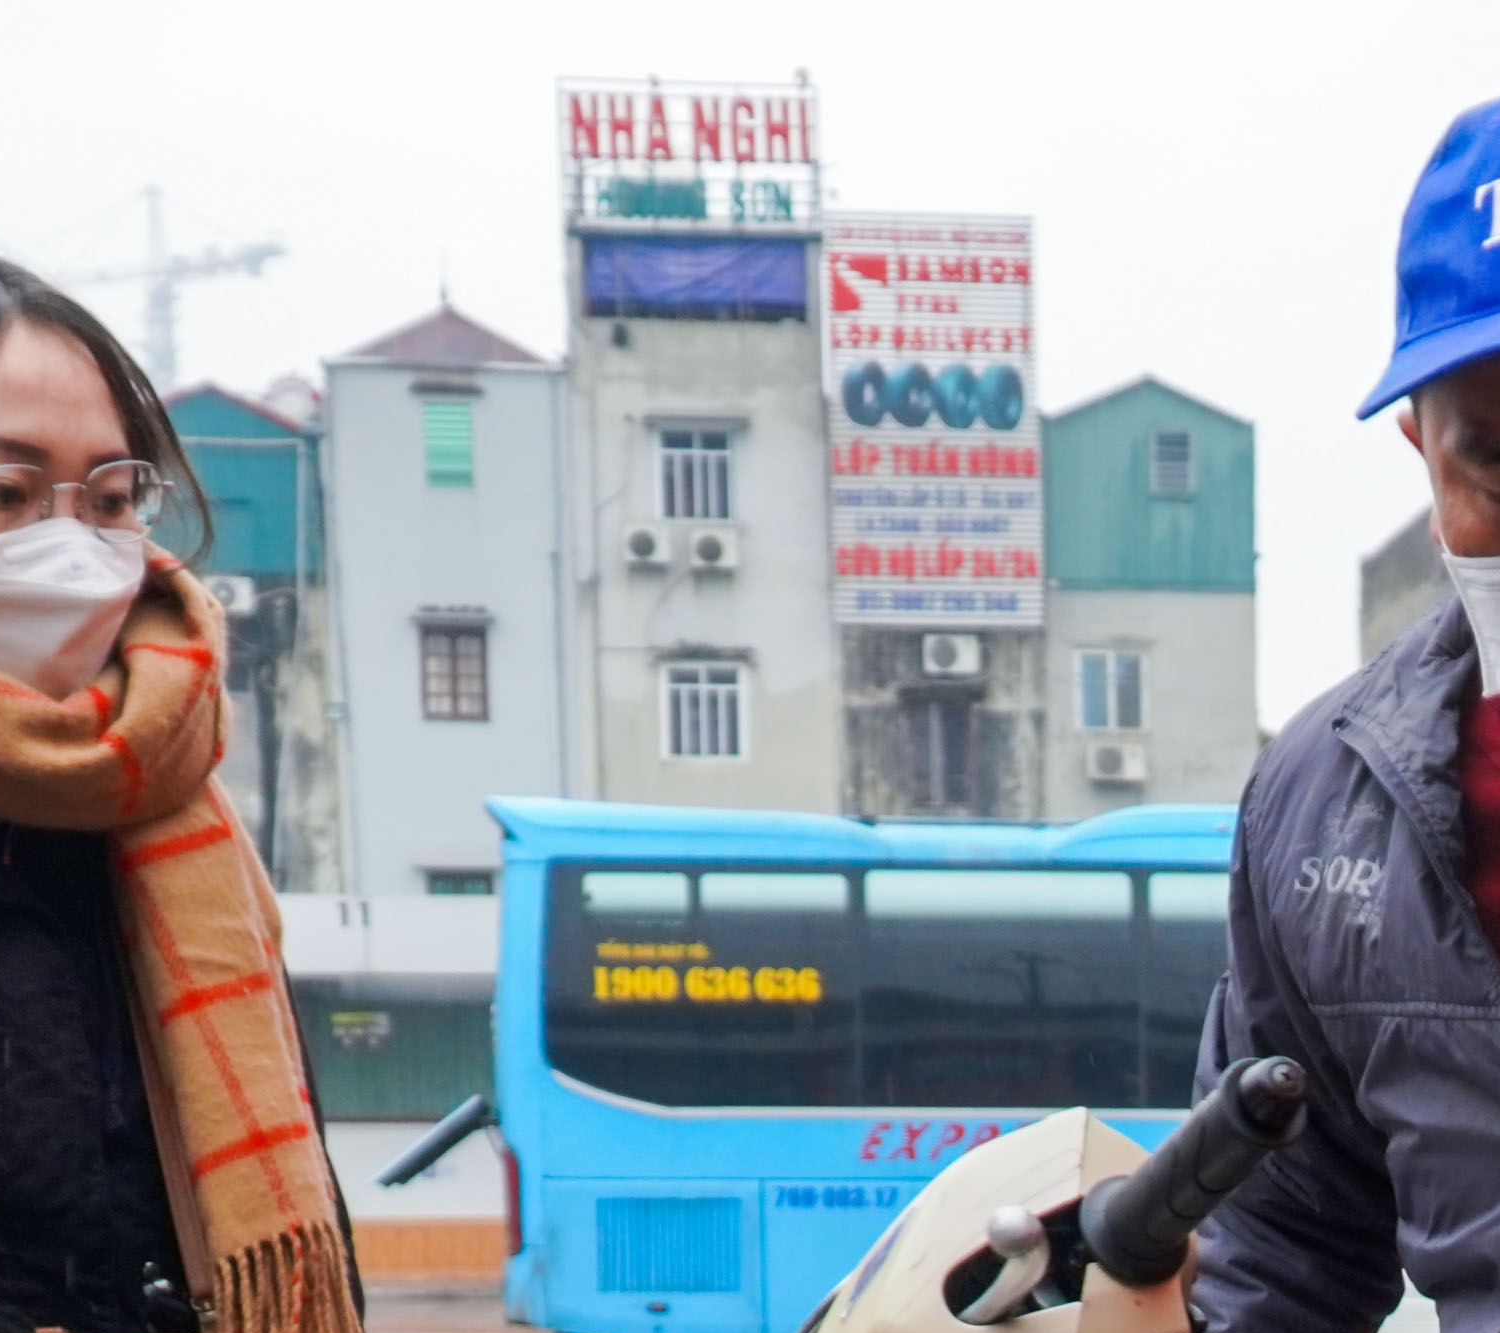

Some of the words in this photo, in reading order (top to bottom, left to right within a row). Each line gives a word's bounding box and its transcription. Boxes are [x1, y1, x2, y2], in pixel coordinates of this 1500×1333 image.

[594, 966, 678, 1001] 1900
[684, 966, 751, 1003] 636
[753, 966, 822, 1003] 636
[859, 1121, 1036, 1161] EXPR
